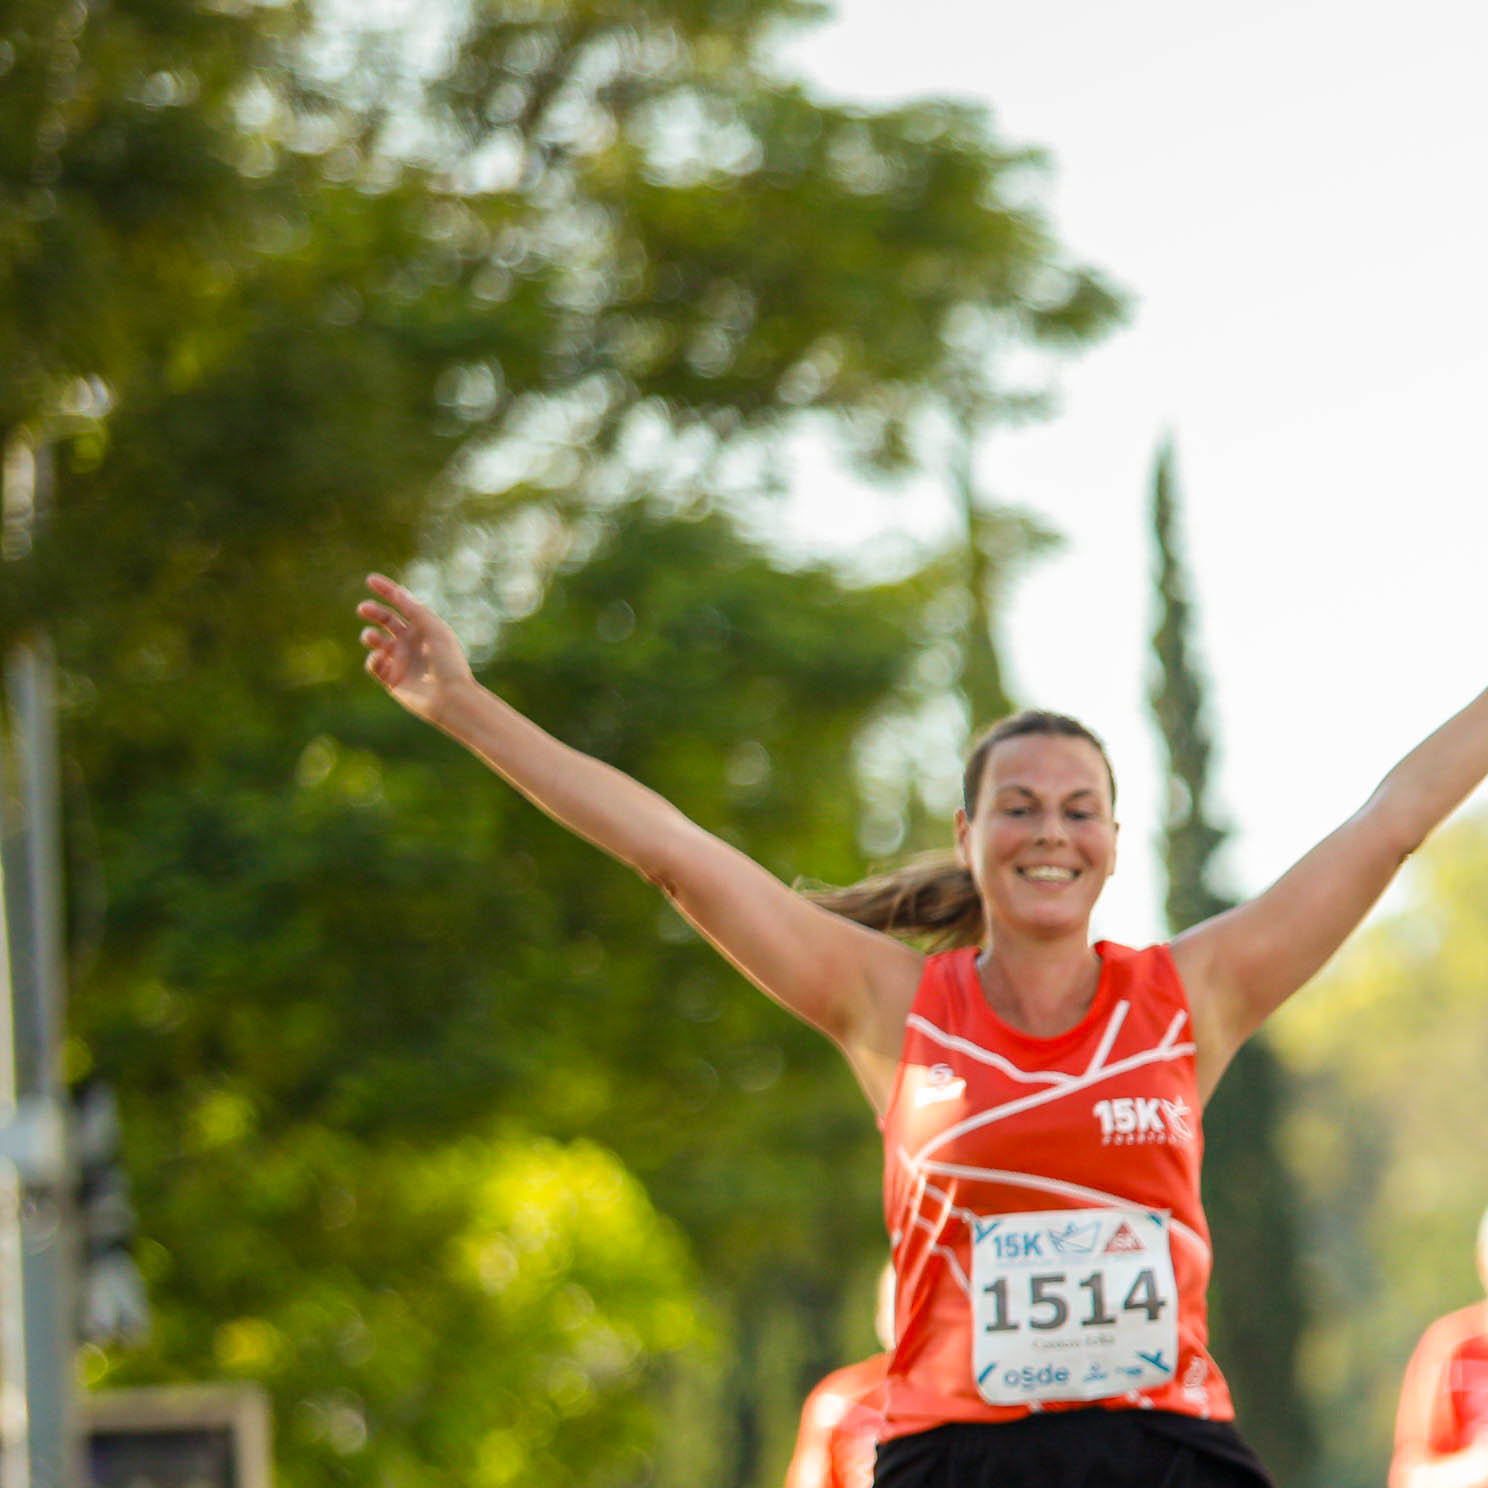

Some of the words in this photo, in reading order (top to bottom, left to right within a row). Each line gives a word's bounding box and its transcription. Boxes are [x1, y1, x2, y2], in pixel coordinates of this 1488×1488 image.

[1092, 1096, 1166, 1136] 15K
[993, 1231, 1042, 1258] 15K
[983, 1267, 1167, 1333] 1514
[1003, 1363, 1070, 1389] osde
